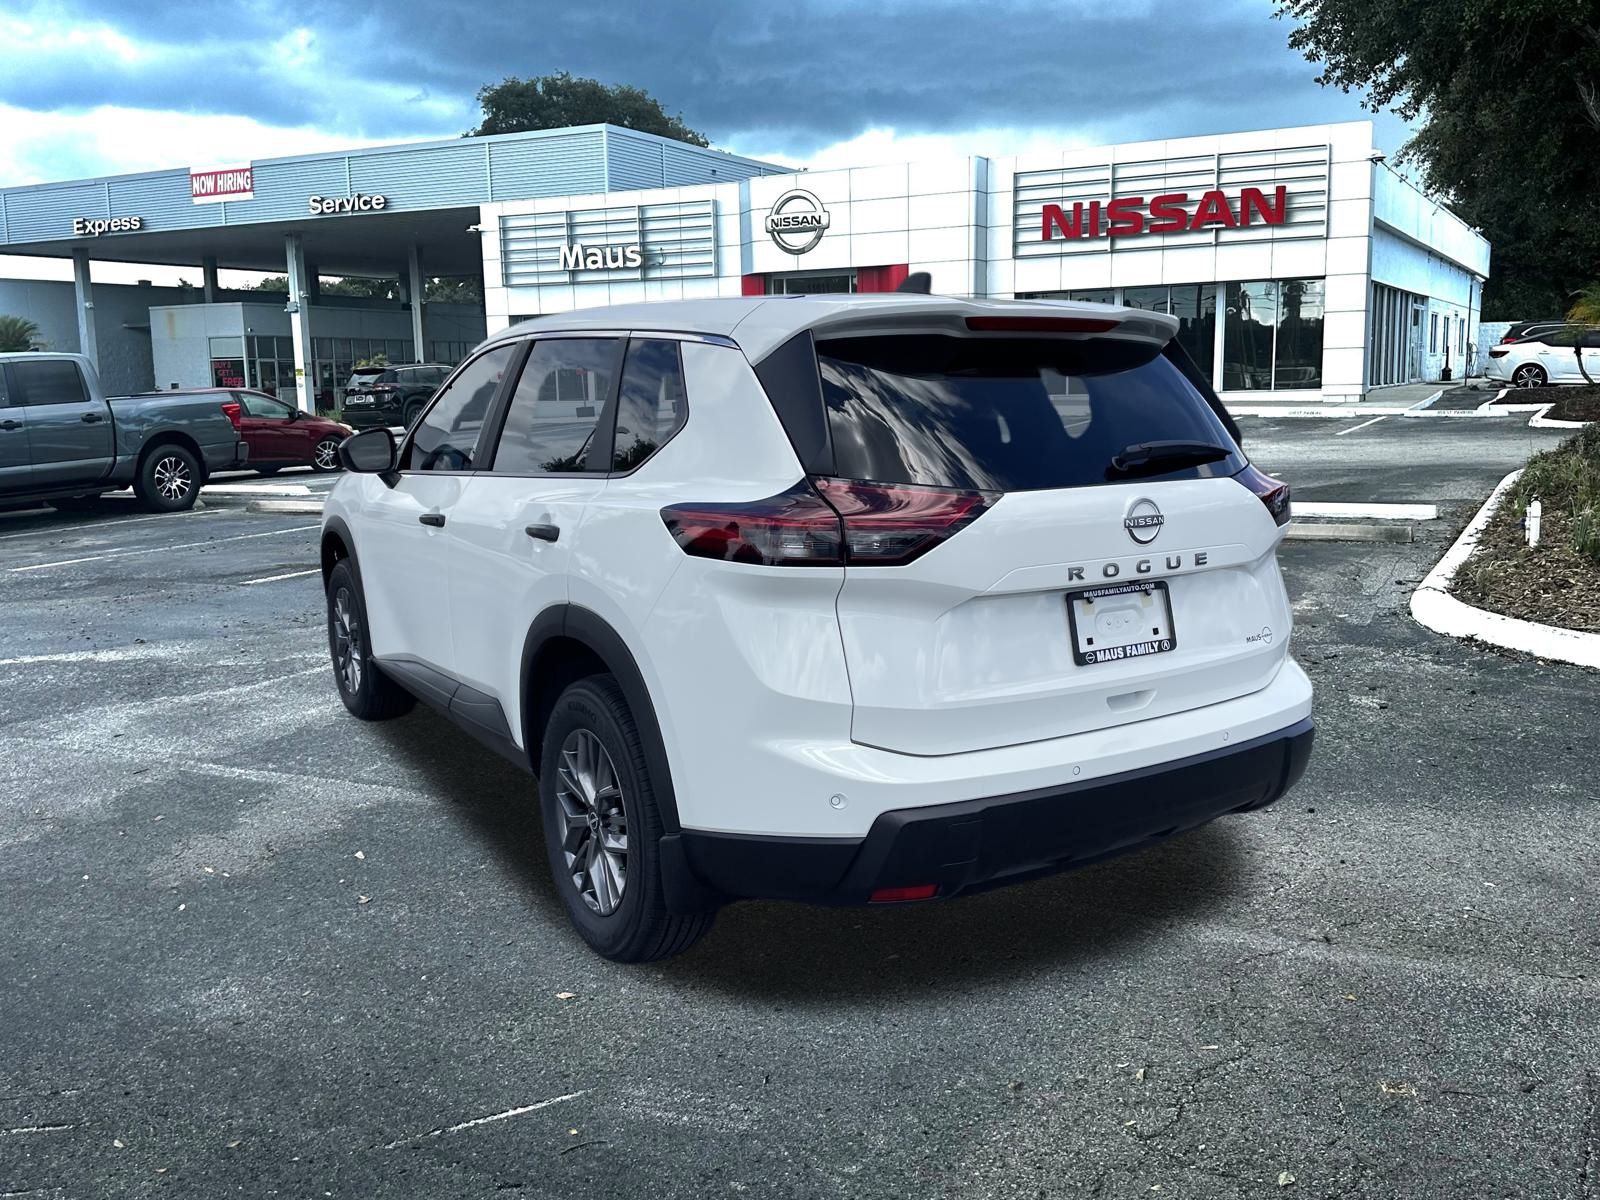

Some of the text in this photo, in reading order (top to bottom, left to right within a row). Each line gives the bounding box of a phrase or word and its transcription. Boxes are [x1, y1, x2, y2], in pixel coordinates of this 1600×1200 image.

[192, 171, 251, 195] NOW HIRING
[309, 193, 385, 215] Service
[1042, 185, 1287, 241] NISSAN
[73, 216, 141, 236] Express
[770, 214, 822, 229] NISSAN
[559, 243, 642, 270] Maus
[223, 377, 244, 387] FREE
[1125, 516, 1164, 527] NISSAN
[1067, 552, 1208, 581] ROGUE
[1083, 583, 1155, 598] MAUSFAMILYAUTO.COM
[1096, 641, 1159, 662] MAUS FAMILY
